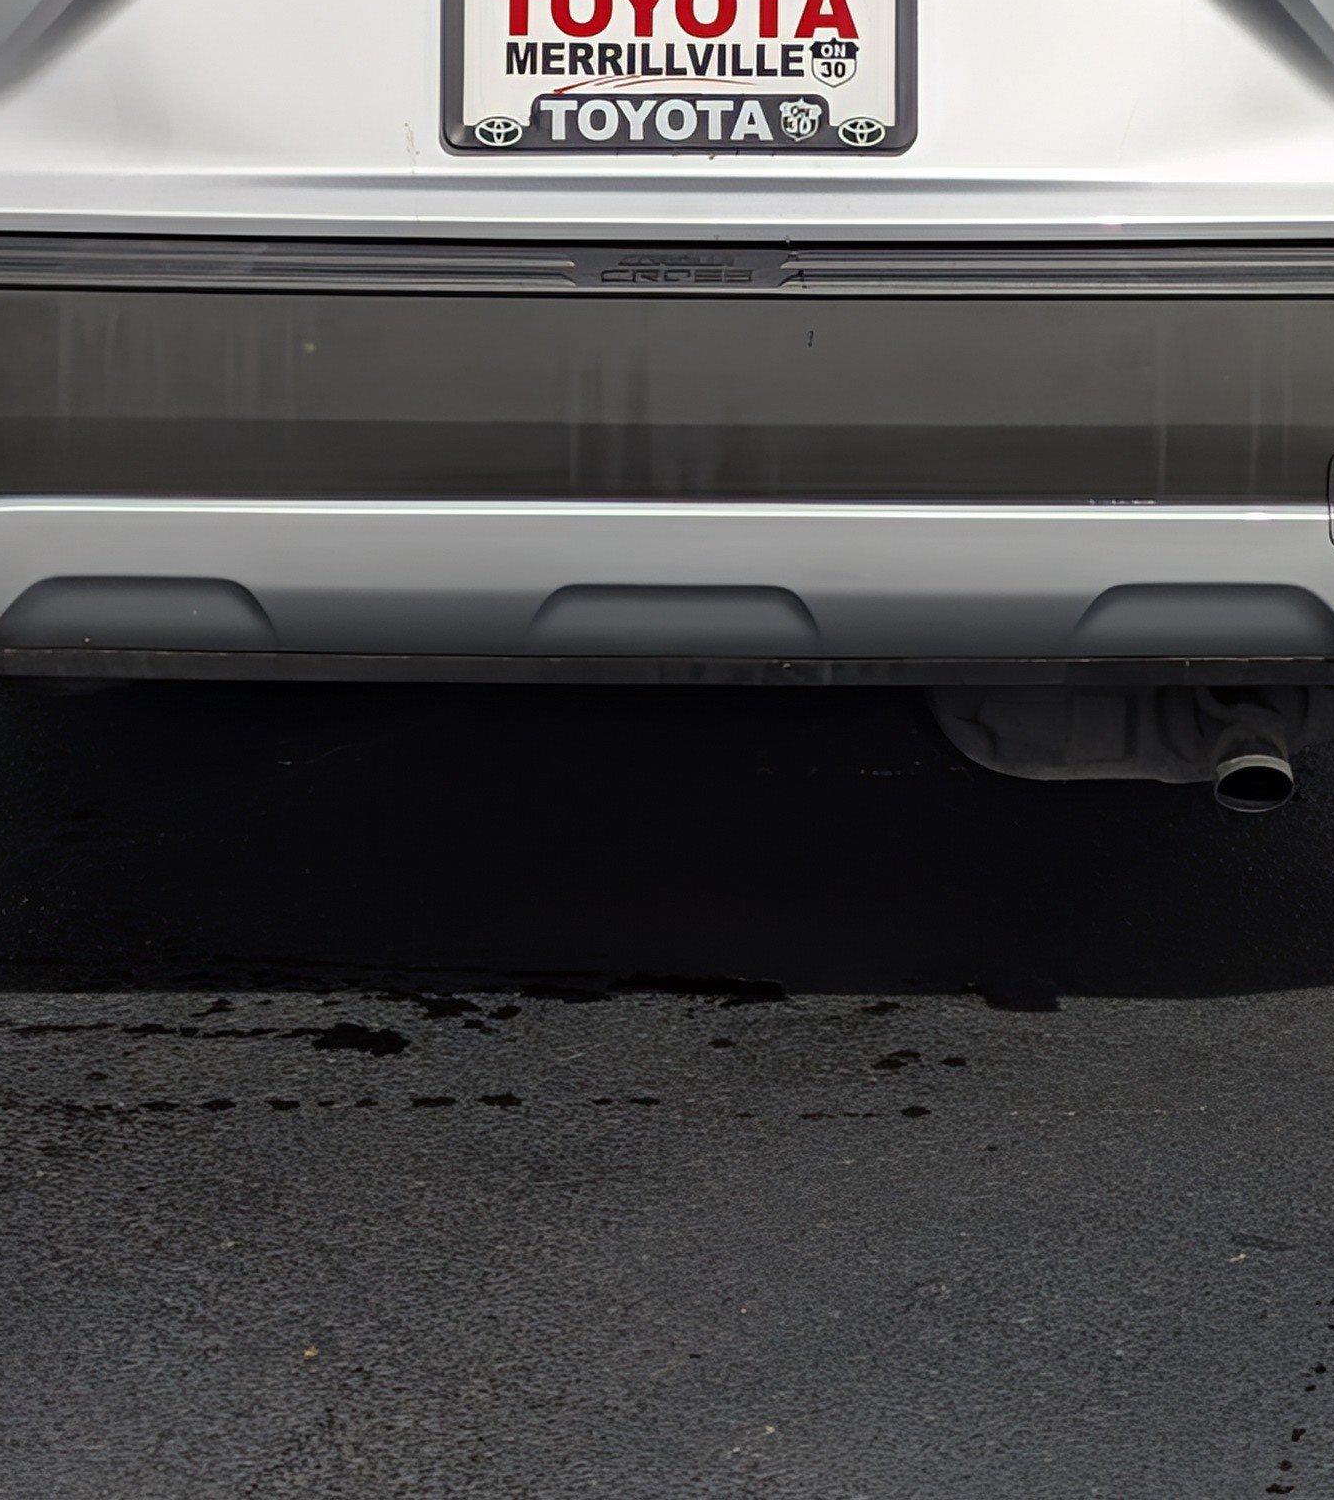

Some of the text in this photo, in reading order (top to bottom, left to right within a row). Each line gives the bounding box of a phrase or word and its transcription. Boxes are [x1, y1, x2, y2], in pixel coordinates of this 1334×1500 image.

[506, 42, 805, 78] MERRILLVILLE
[820, 44, 846, 57] ON
[820, 61, 846, 78] 30
[540, 99, 774, 141] TOYOTA
